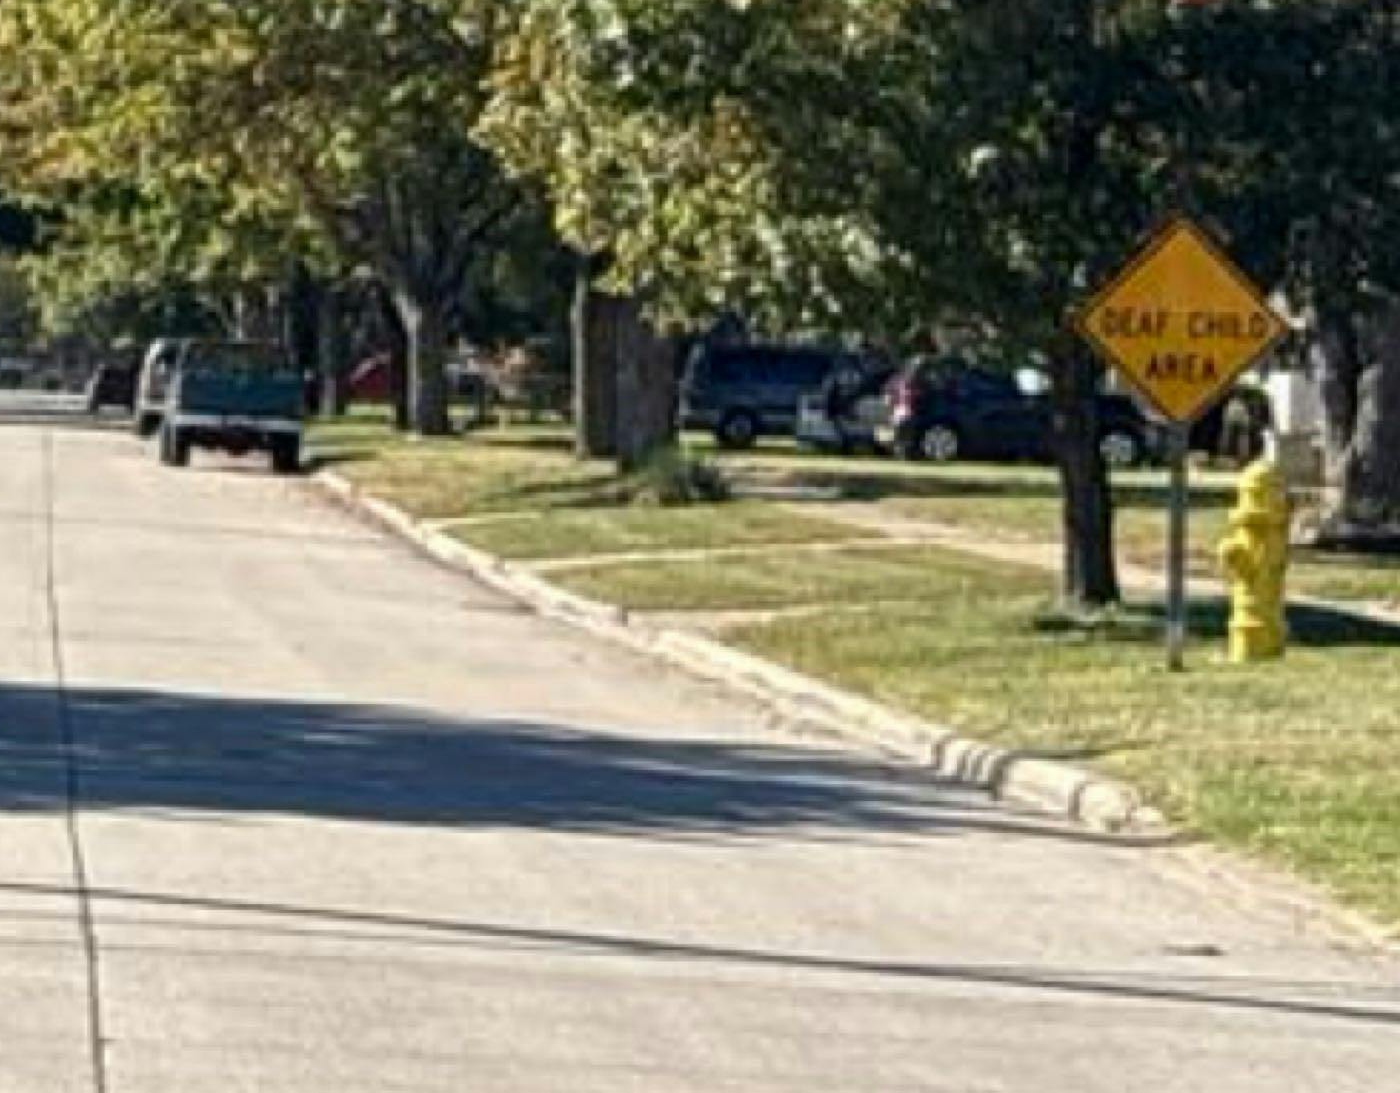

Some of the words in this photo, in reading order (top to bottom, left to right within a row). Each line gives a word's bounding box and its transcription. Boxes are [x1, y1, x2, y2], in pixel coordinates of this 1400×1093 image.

[1103, 308, 1168, 338] DEAF
[1188, 310, 1267, 339] CHILD
[1146, 354, 1219, 383] AREA
